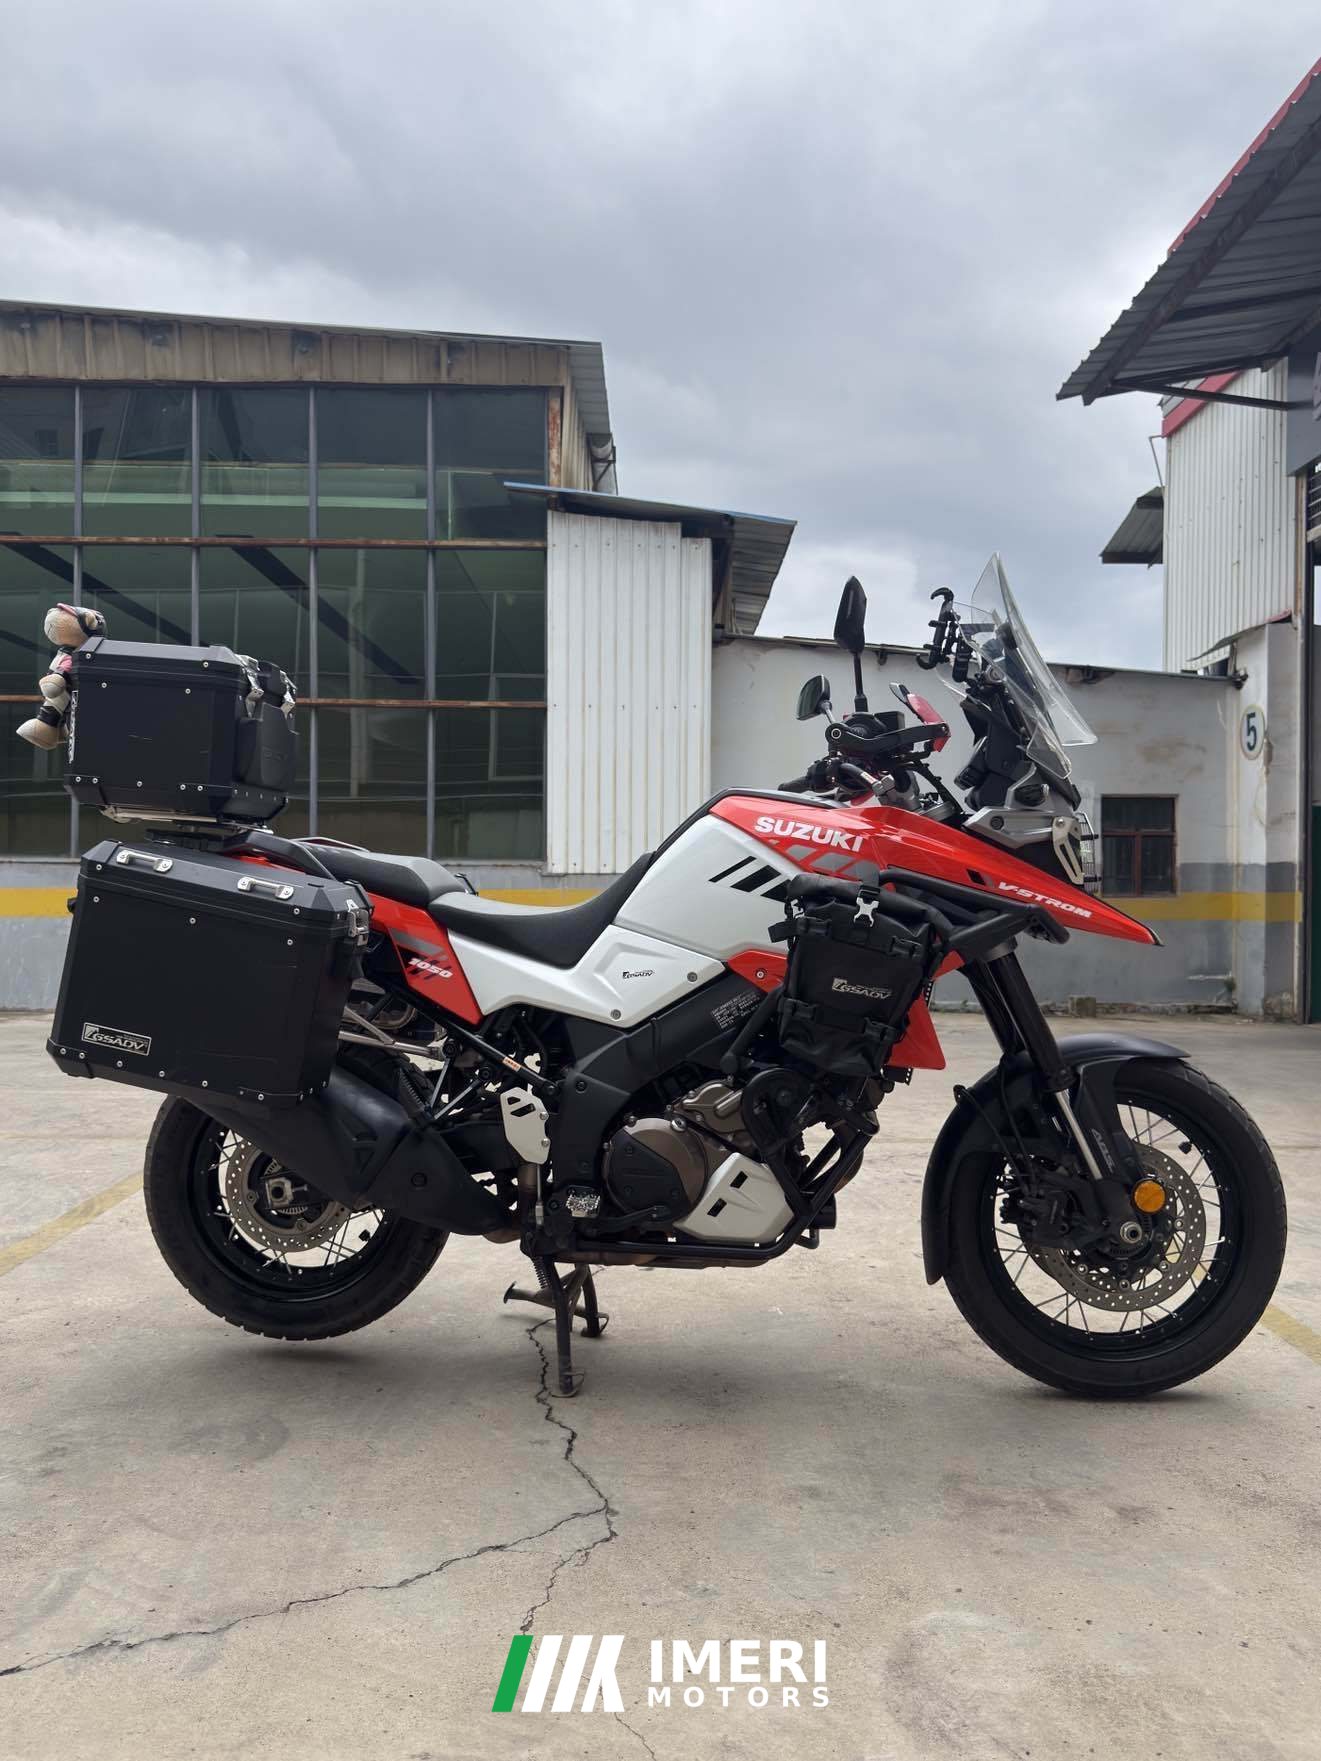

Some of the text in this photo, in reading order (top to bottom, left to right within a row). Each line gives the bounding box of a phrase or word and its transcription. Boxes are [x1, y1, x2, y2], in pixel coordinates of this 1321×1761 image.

[1246, 711, 1257, 751] 5
[754, 816, 863, 852] SUZUKI
[408, 957, 453, 978] 1050
[92, 1033, 145, 1050] GSADV
